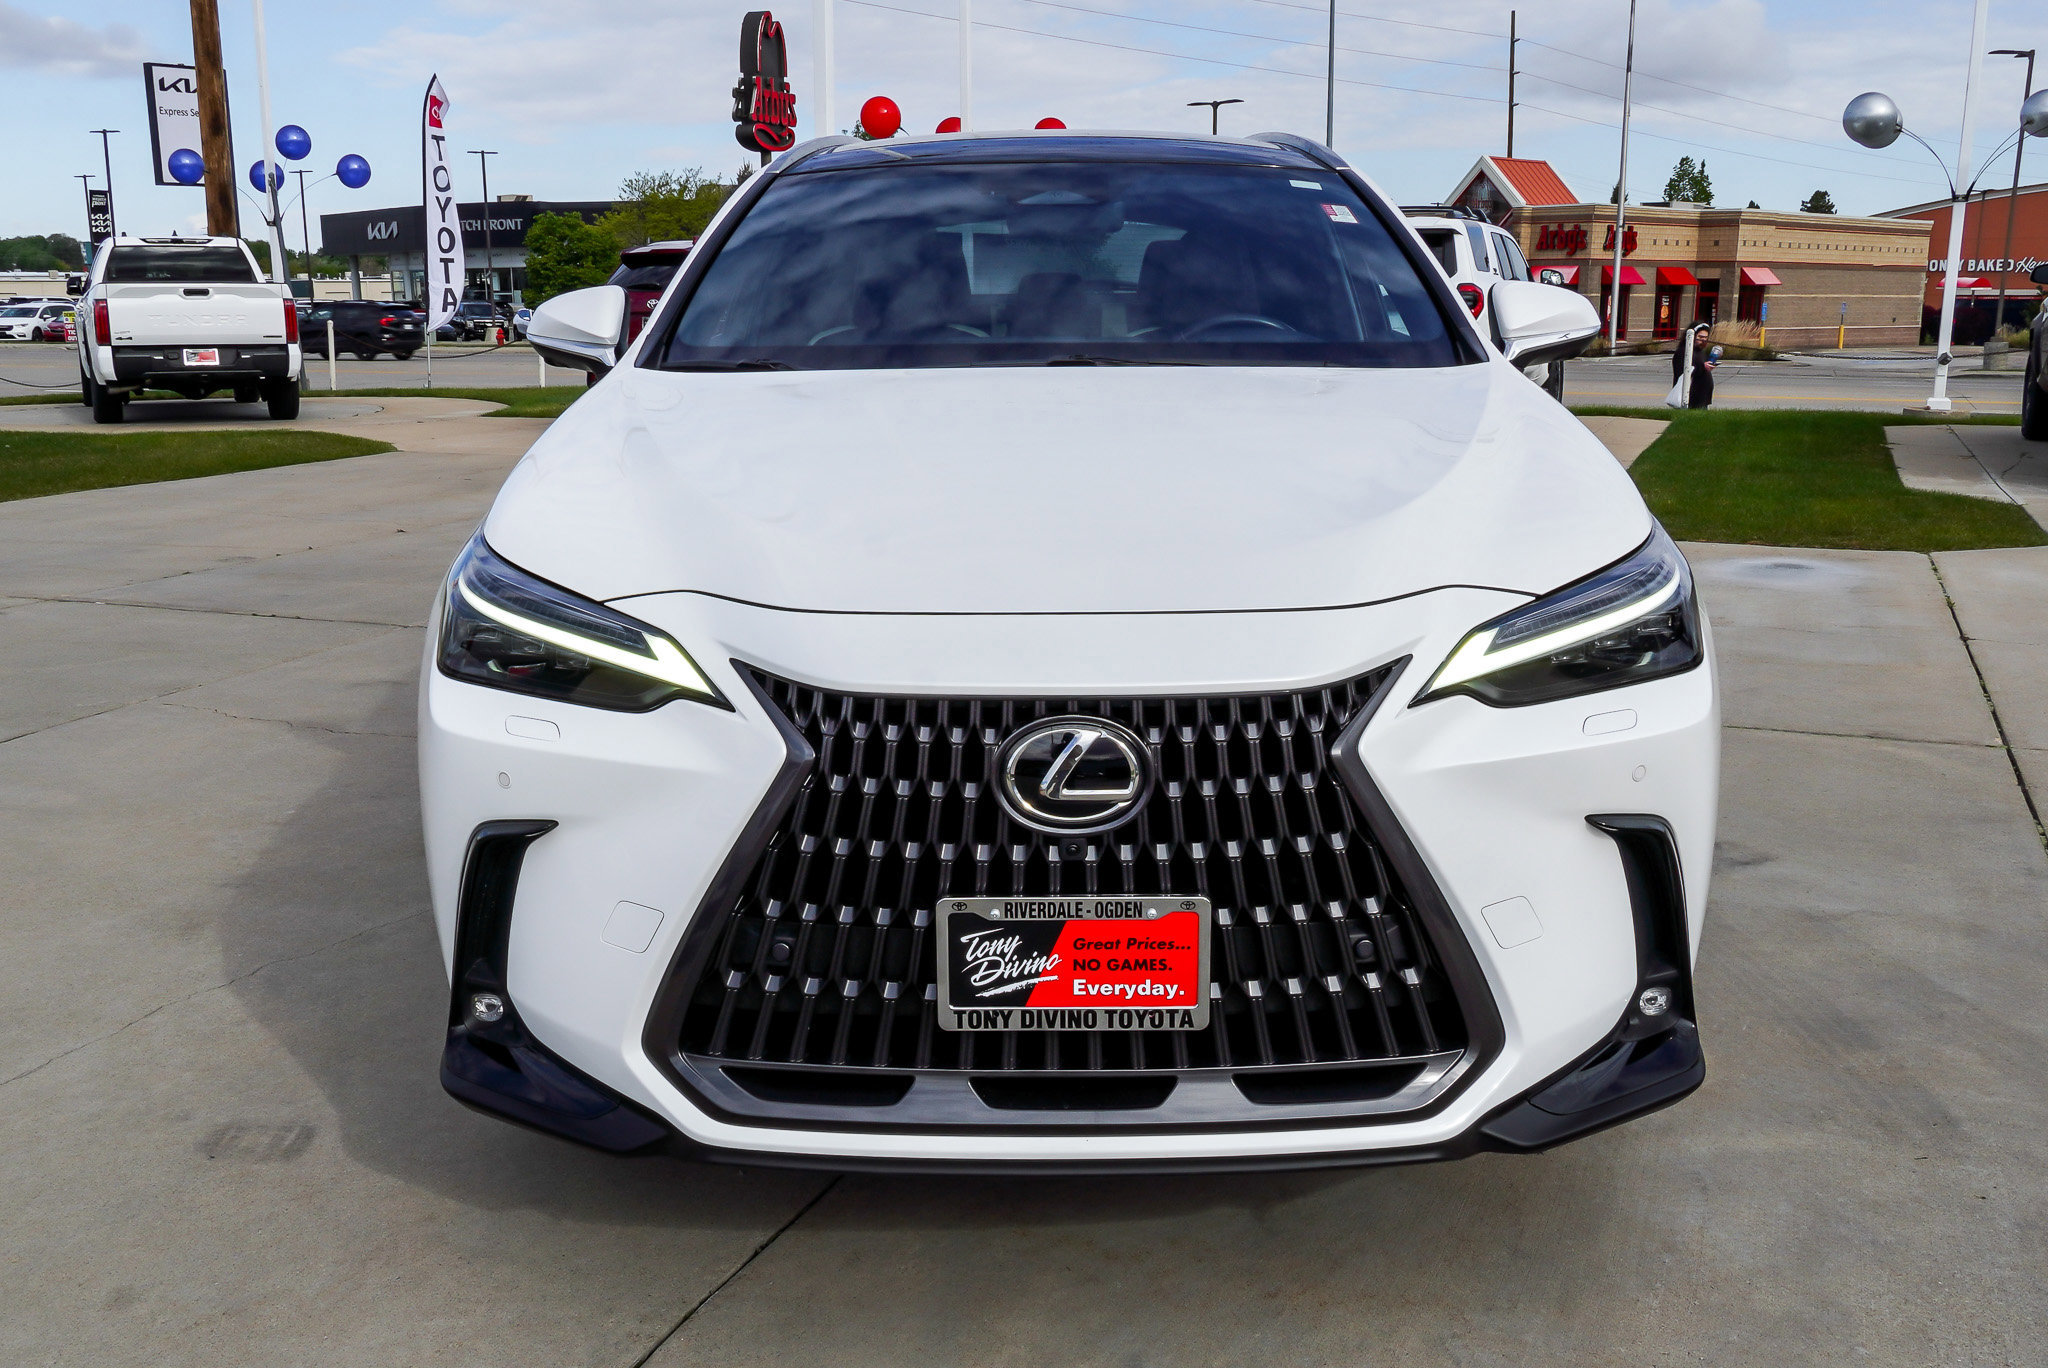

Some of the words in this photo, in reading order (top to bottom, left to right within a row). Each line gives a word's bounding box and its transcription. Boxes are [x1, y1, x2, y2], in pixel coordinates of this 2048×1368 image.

[159, 77, 197, 93] KI
[159, 106, 188, 117] Express
[367, 221, 399, 241] KIA
[431, 134, 457, 313] TOYOTA
[1536, 223, 1588, 256] Arby's
[1603, 224, 1638, 258] Ay's
[1929, 259, 1965, 272] ONY
[1004, 901, 1083, 919] RIVERDALE
[1094, 901, 1143, 919] OGDEN
[960, 927, 1022, 962] Tony
[1073, 937, 1121, 951] Great
[1126, 937, 1192, 951] Prices...
[961, 952, 1063, 986] Divino
[1073, 959, 1101, 972] NO
[1106, 959, 1173, 972] GAMES.
[1073, 979, 1185, 1000] Everyday.
[954, 1010, 1013, 1029] TONY
[1021, 1010, 1097, 1029] DIVINO
[1104, 1010, 1195, 1029] TOYOTA
